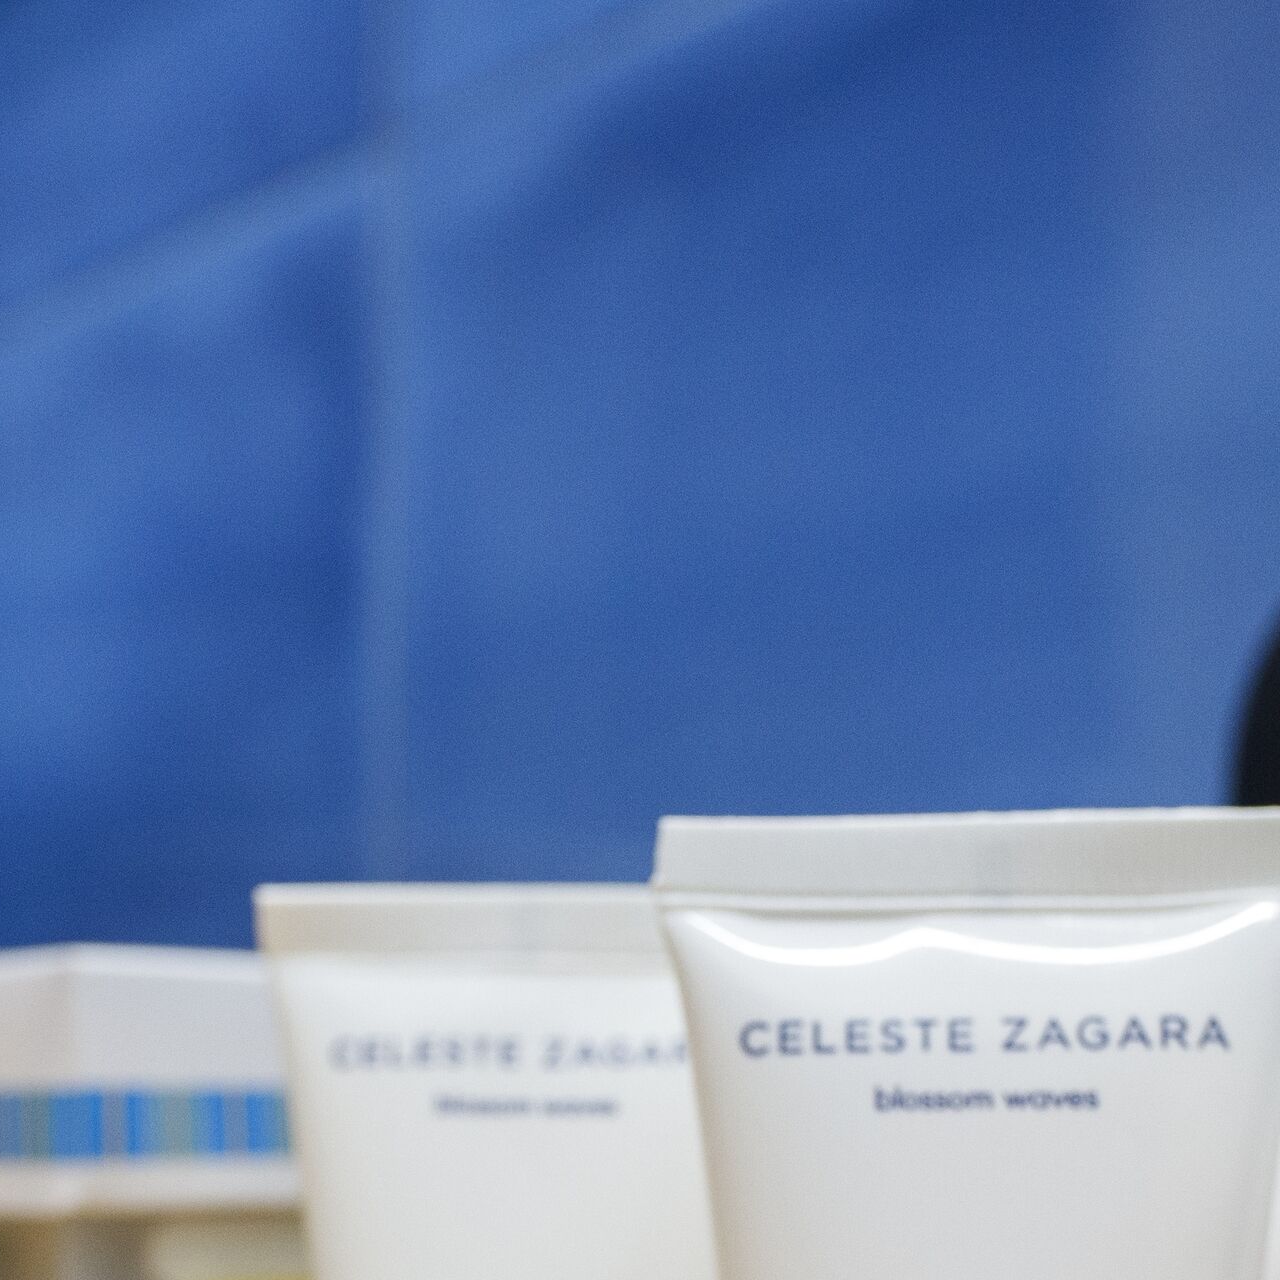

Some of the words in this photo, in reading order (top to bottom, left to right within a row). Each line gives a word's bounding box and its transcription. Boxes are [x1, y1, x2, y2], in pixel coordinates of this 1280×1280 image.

[326, 1034, 521, 1073] CELESTE
[735, 1018, 975, 1060] CELESTE
[1000, 1013, 1233, 1054] ZAGARA
[872, 1086, 996, 1114] blossom
[1002, 1089, 1101, 1112] waves
